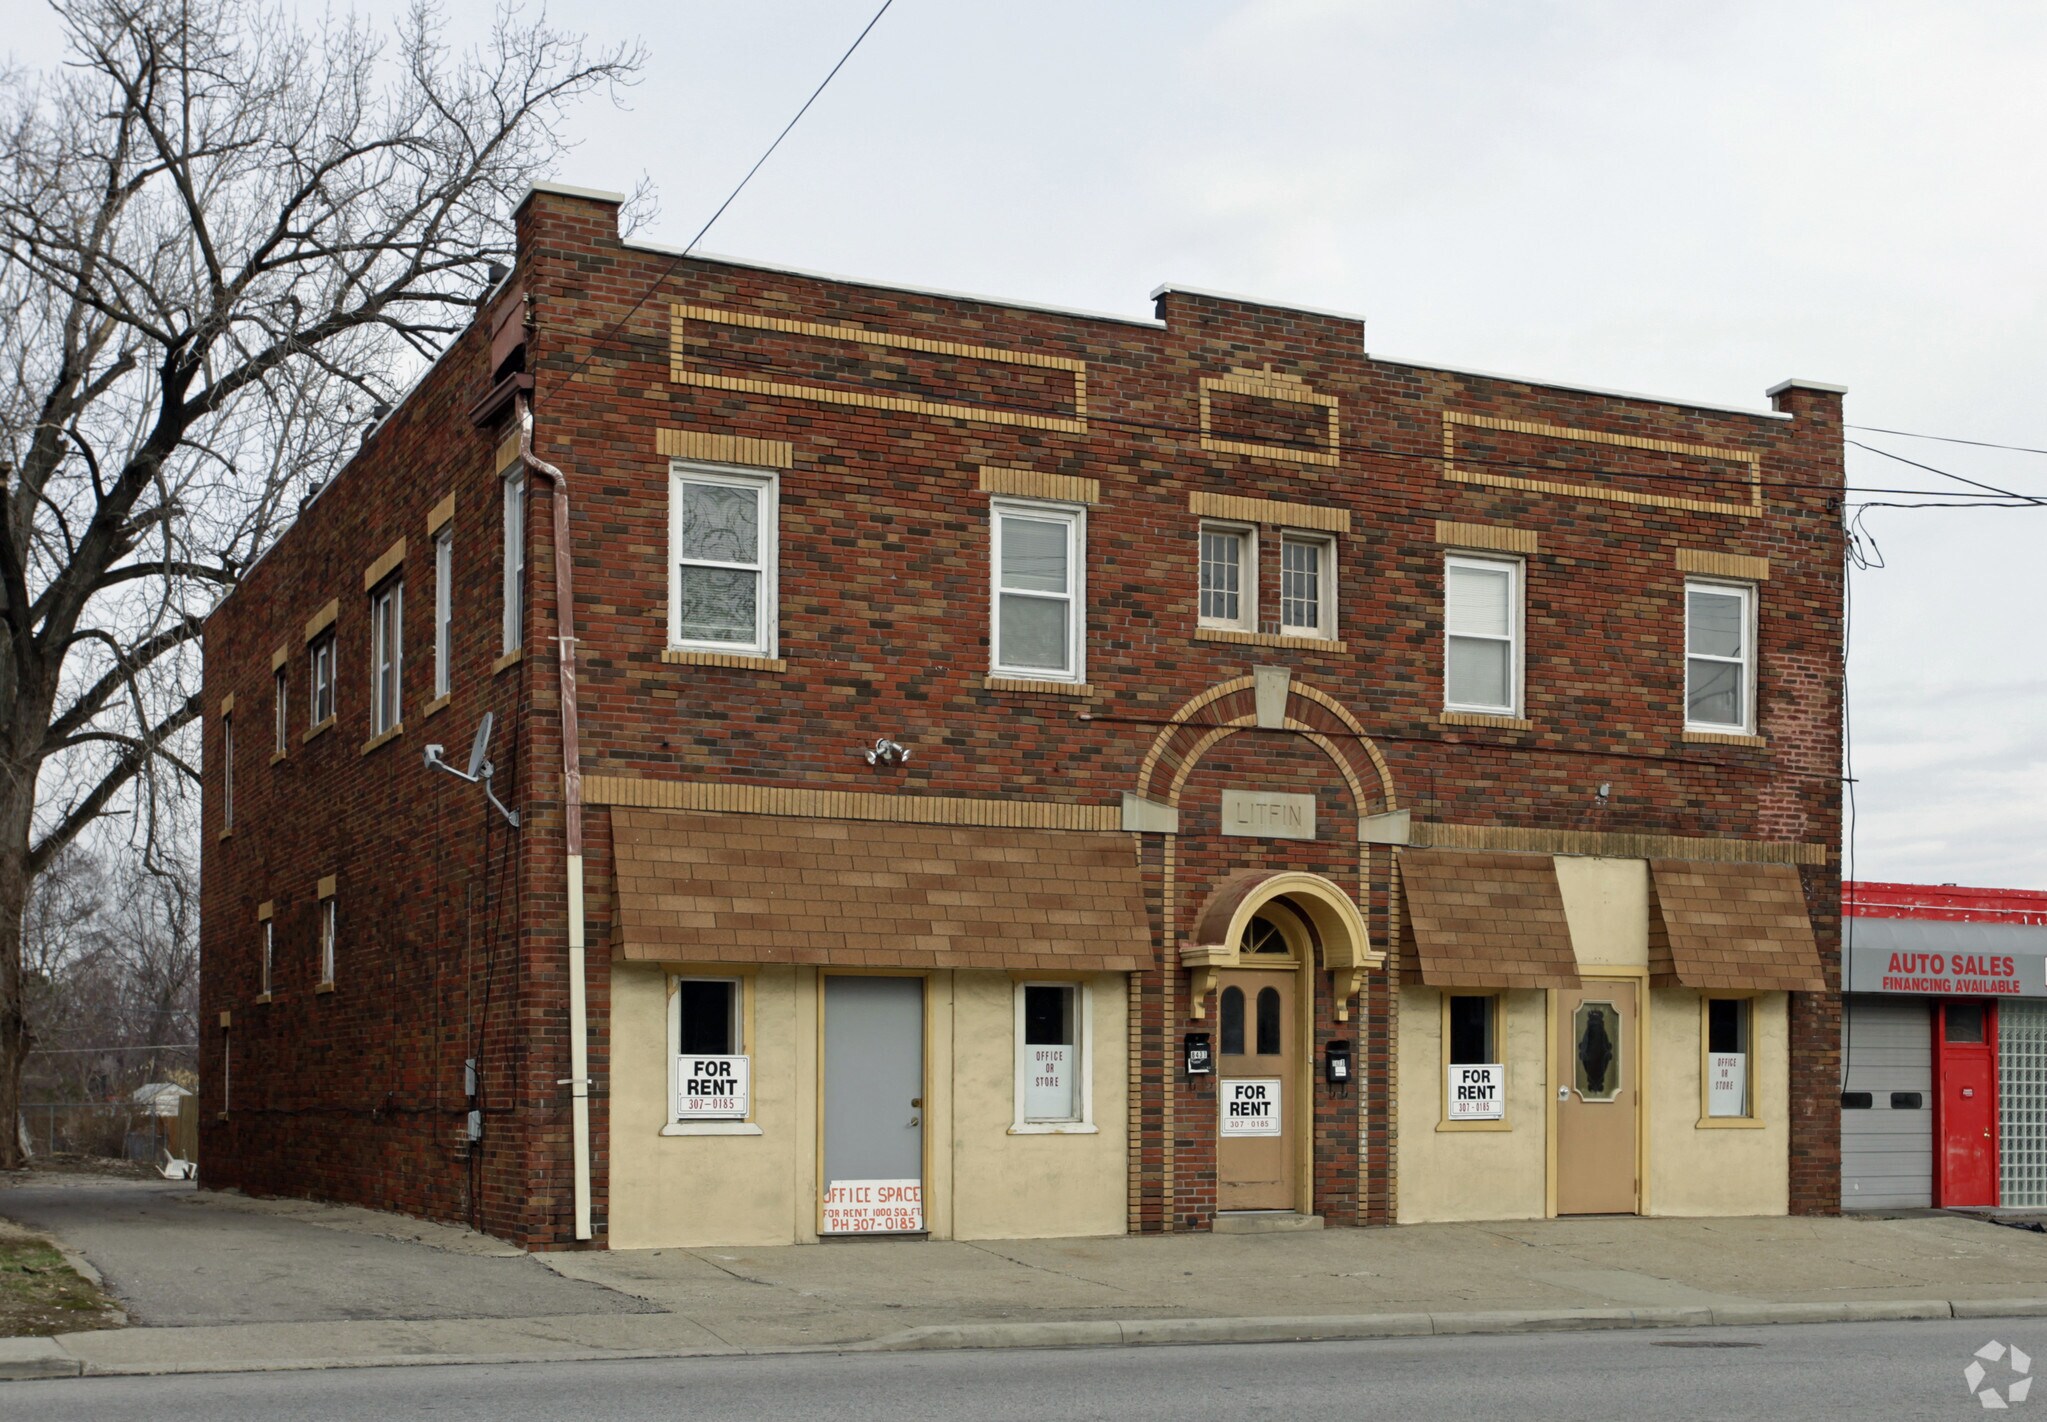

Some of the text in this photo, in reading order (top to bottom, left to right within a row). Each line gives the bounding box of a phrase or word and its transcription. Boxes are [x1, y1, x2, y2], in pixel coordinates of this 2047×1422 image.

[1236, 802, 1302, 826] LITFIN
[1888, 952, 2015, 977] AUTO SALES
[1882, 976, 2020, 993] FINANCING AVAILABLE
[1036, 1051, 1063, 1061] OFFICE
[1717, 1058, 1737, 1067] OFFICE
[694, 1061, 731, 1076] FOR
[1046, 1063, 1054, 1073] OR
[1721, 1069, 1728, 1078] OR
[1035, 1077, 1059, 1087] STORE
[1462, 1069, 1490, 1083] FOR
[687, 1079, 737, 1095] RENT
[1235, 1085, 1265, 1100] FOR
[1458, 1085, 1496, 1099] RENT
[1715, 1081, 1733, 1090] STORE
[1230, 1101, 1271, 1116] RENT
[878, 1186, 921, 1203] SPACE
[823, 1209, 840, 1218] FOR
[843, 1208, 868, 1217] RENT
[873, 1207, 892, 1217] 1000
[832, 1218, 849, 1231] PH
